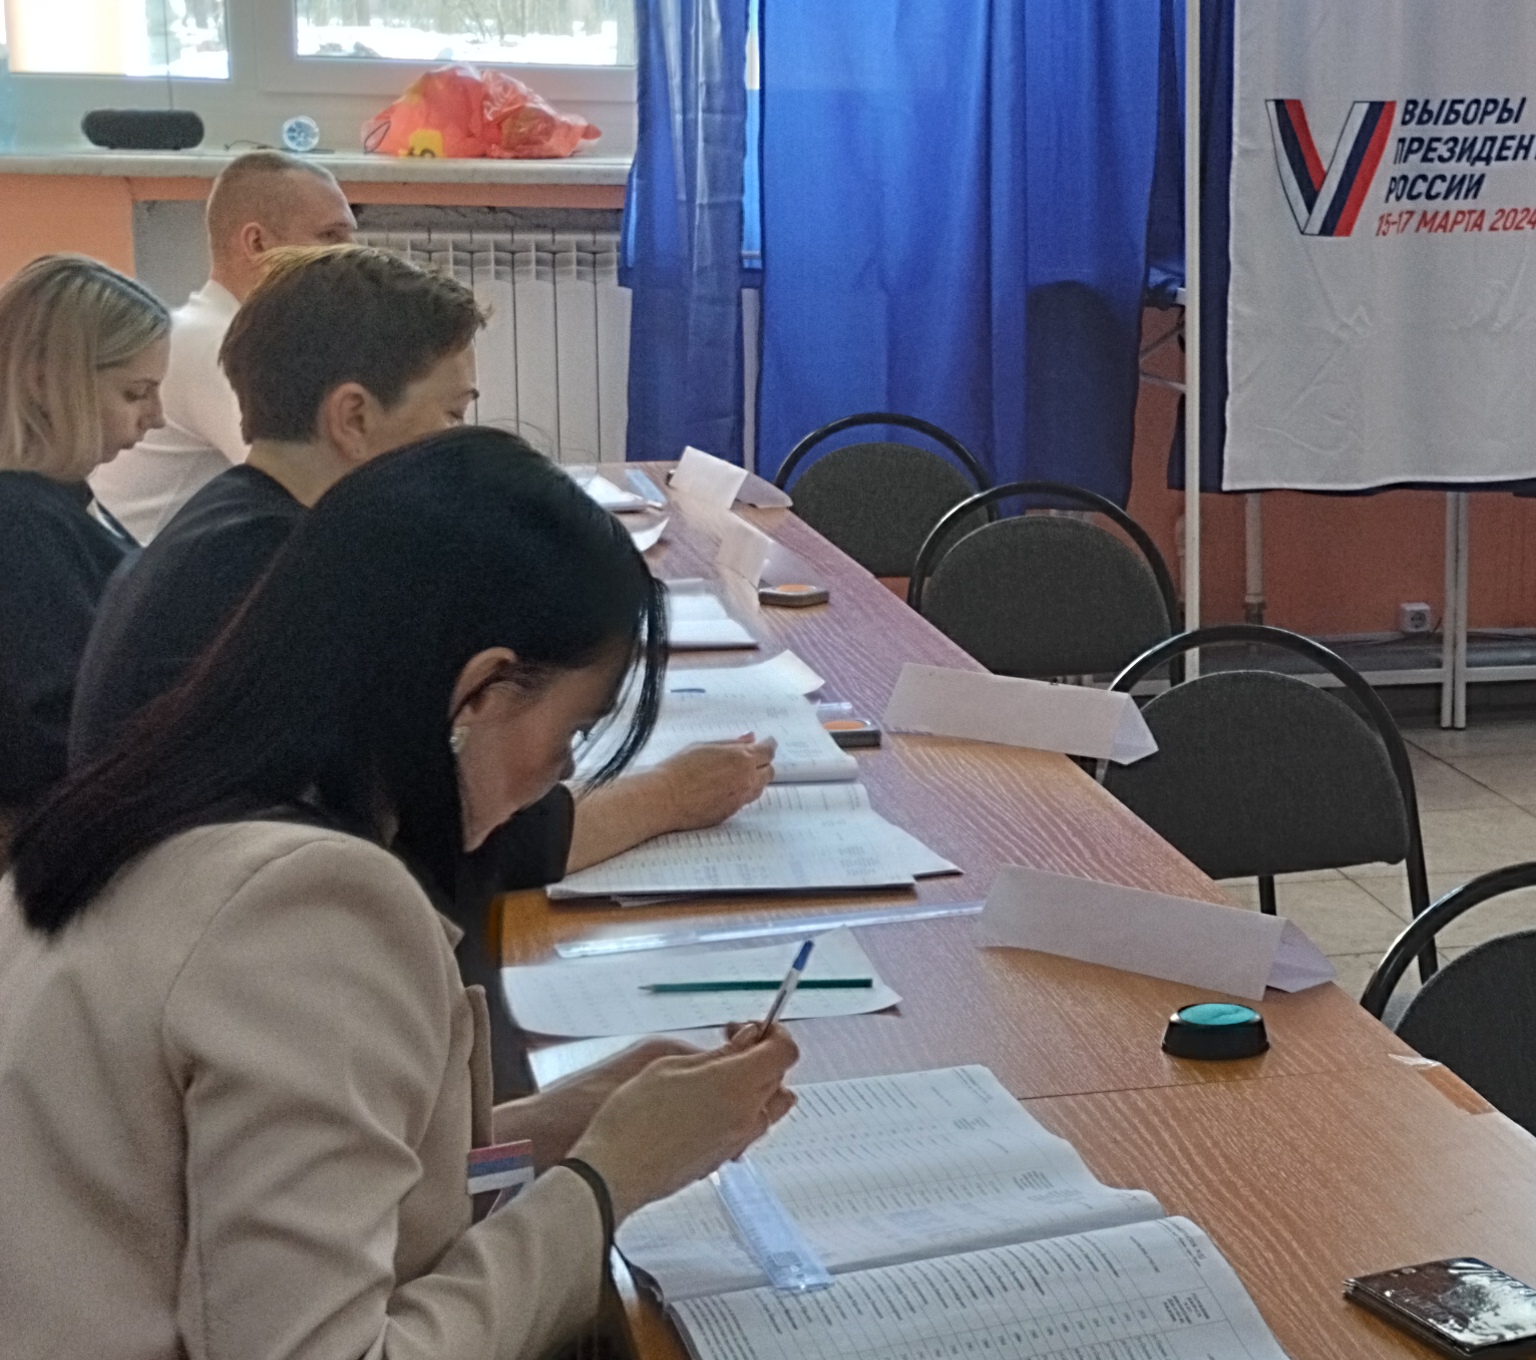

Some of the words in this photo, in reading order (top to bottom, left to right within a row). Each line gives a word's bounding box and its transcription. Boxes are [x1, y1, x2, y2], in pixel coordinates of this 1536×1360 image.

[1400, 97, 1527, 126] ВЫБОРЫ
[1385, 173, 1486, 203] РОССИИ
[1375, 210, 1416, 236] 15-17
[1415, 208, 1486, 233] МАРТА
